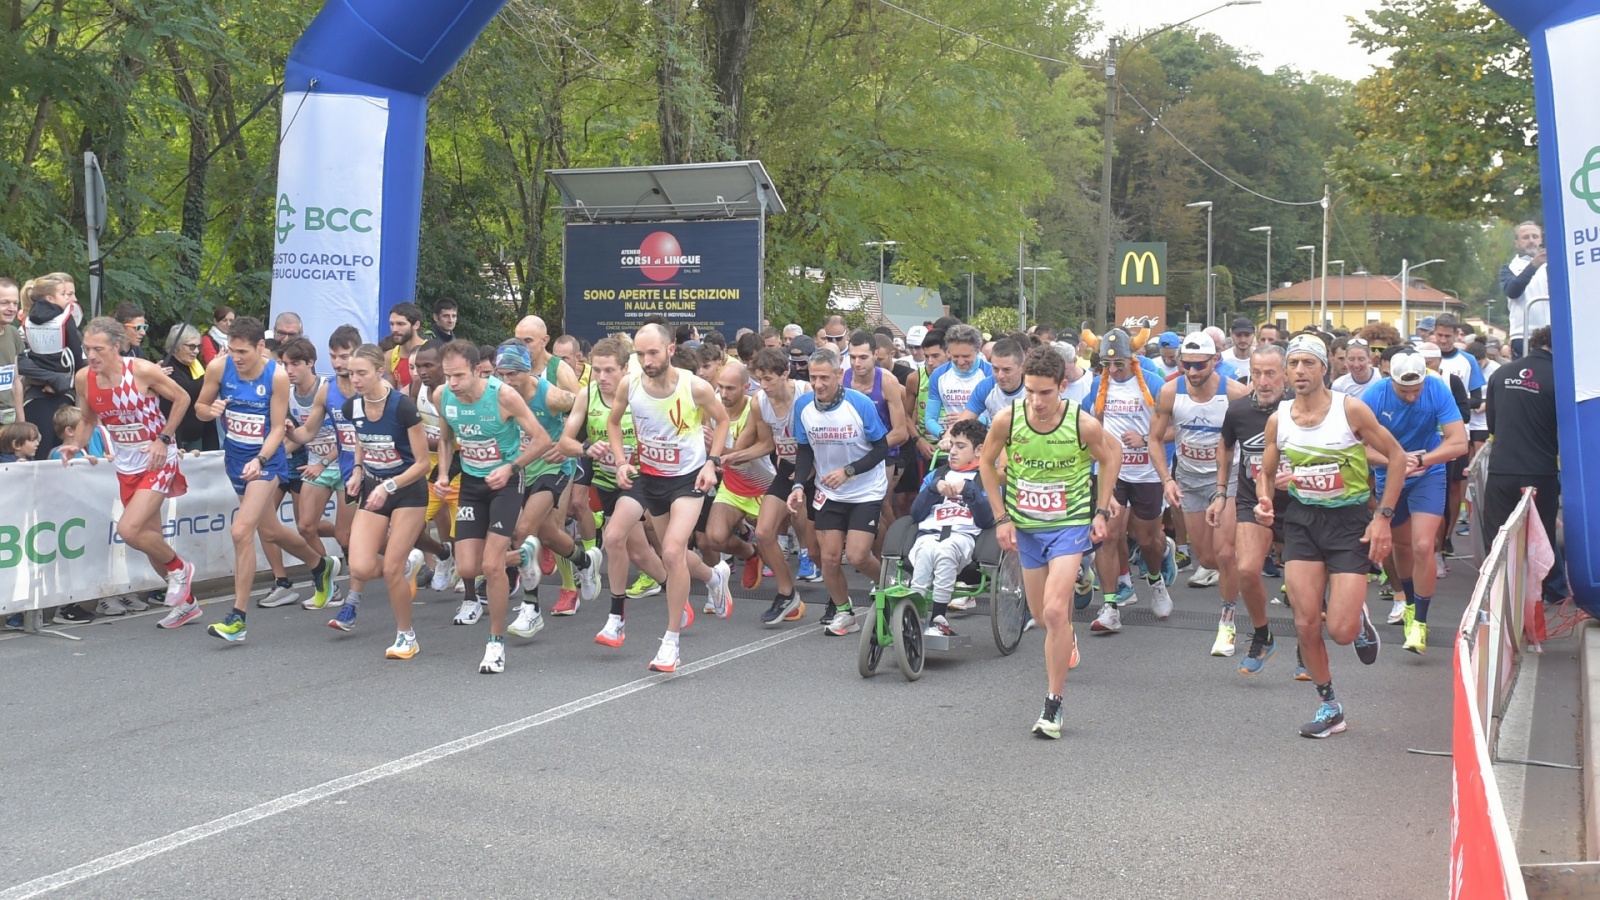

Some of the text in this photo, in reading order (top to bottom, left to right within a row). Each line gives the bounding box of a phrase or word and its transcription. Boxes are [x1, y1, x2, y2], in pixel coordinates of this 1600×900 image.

[304, 207, 373, 233] BCC
[1573, 226, 1600, 246] BU
[300, 253, 374, 267] GAROLFO
[620, 256, 651, 265] CORSI
[664, 255, 701, 264] LINGUE
[1575, 250, 1585, 267] E
[583, 288, 740, 300] SONO APERTE LE ISCRIZIONI
[624, 301, 696, 310] IN AULA E ONLINE
[227, 418, 262, 435] 2042
[115, 430, 142, 442] 2171
[343, 431, 356, 443] 21
[363, 448, 397, 461] 2006
[461, 446, 498, 459] 2002
[641, 445, 675, 461] 2018
[780, 443, 798, 455] 20
[1184, 446, 1216, 460] 2133
[1023, 457, 1076, 469] MERCURIO
[1297, 474, 1335, 490] 2187
[1019, 490, 1062, 509] 2003
[940, 507, 969, 518] 3272
[0, 517, 86, 569] BCC
